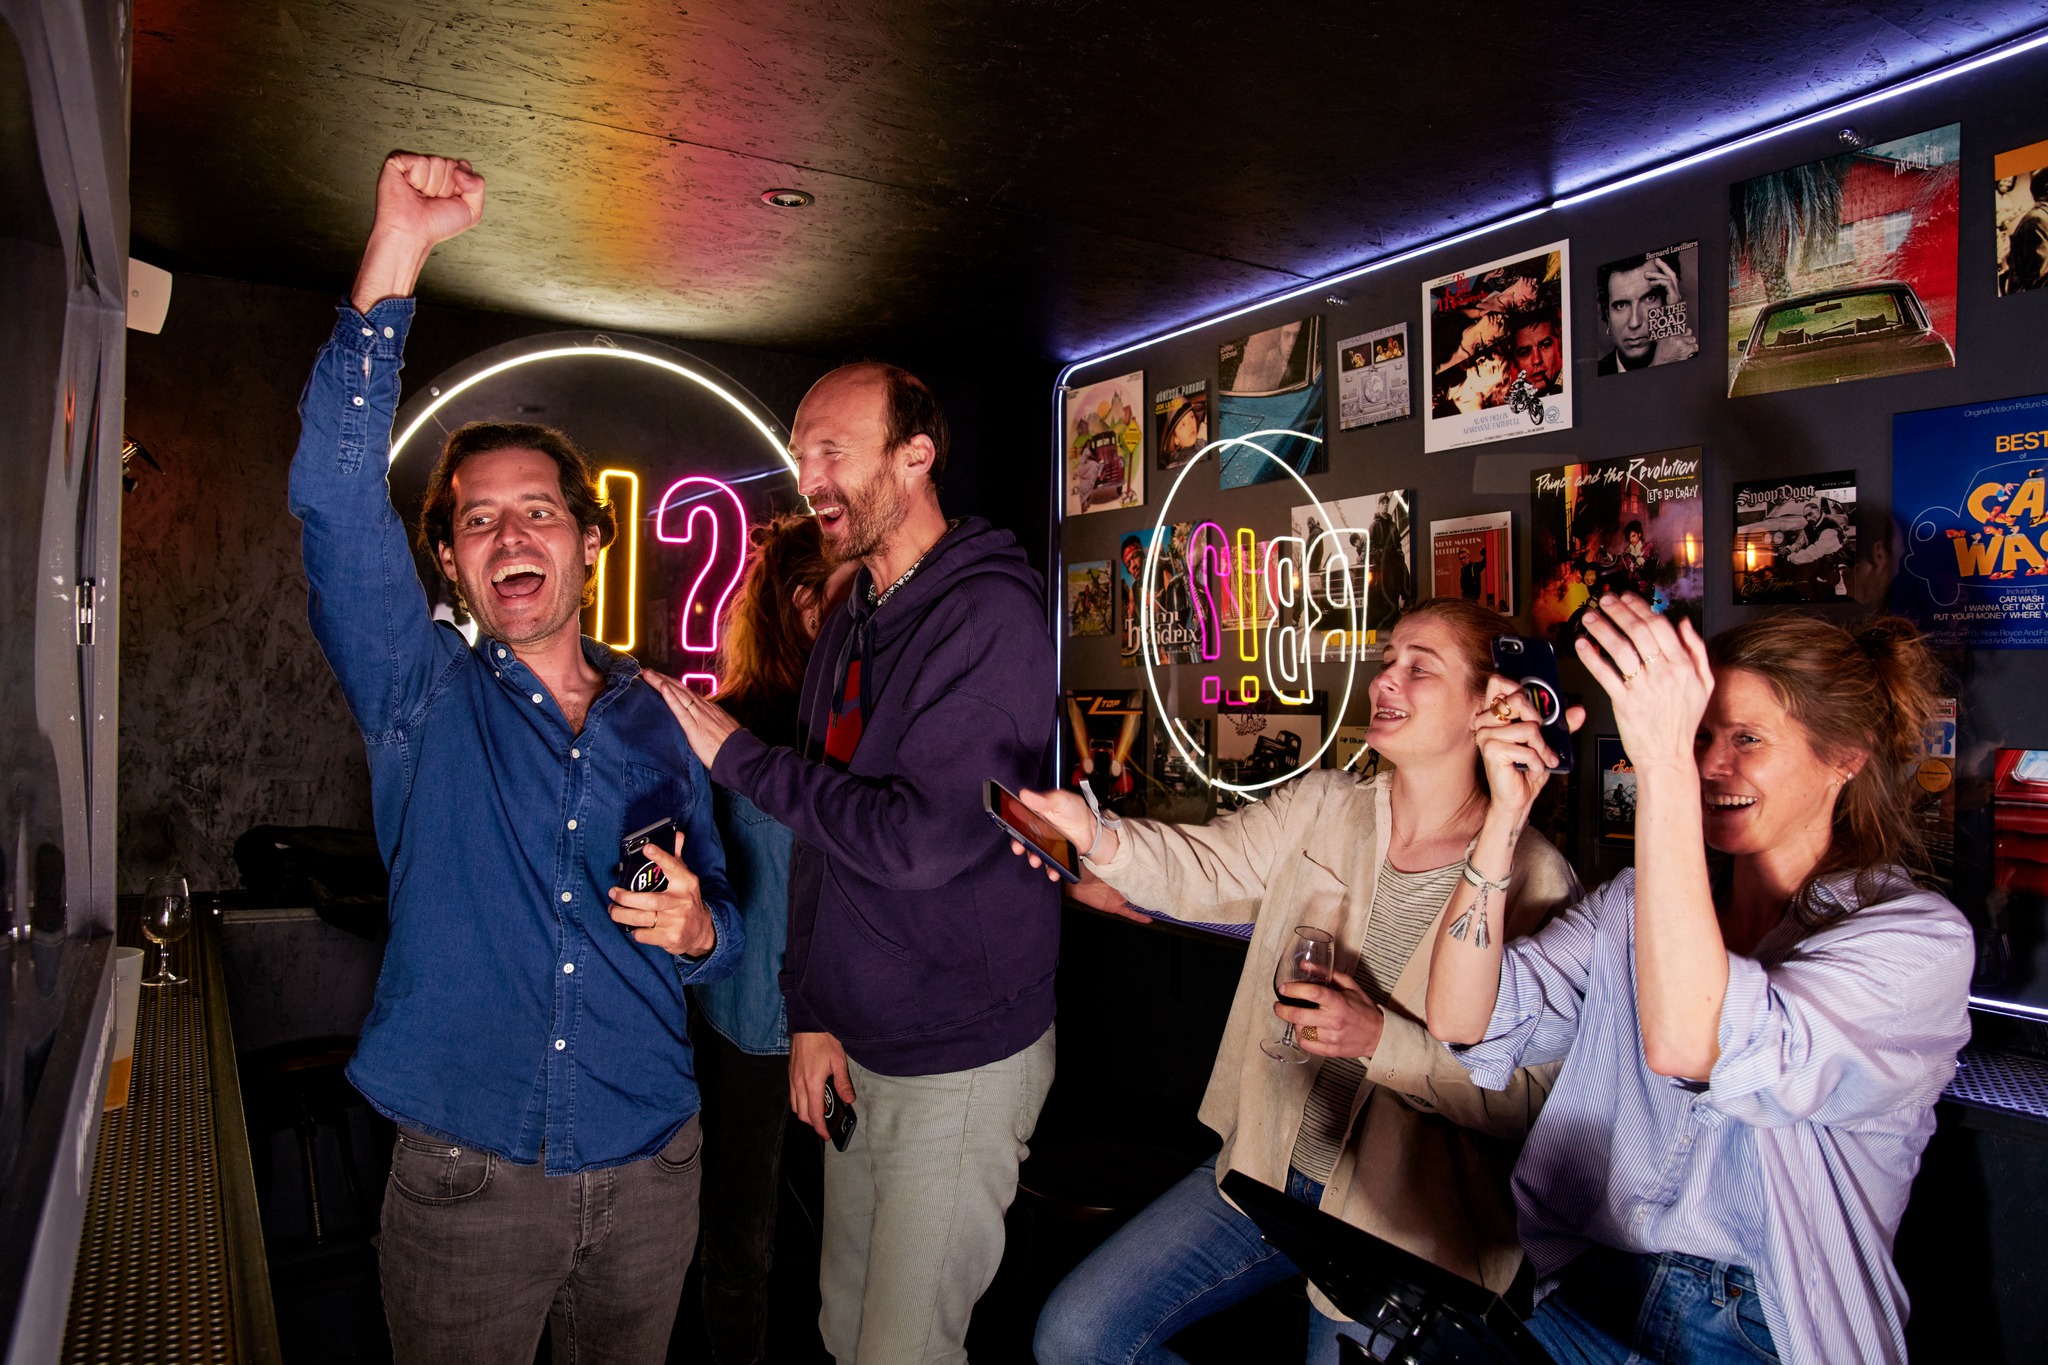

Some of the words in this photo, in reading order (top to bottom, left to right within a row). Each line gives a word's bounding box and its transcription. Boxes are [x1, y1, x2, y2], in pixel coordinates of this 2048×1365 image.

[1894, 152, 1929, 178] ARCADE
[1645, 246, 1670, 261] Bernard
[1670, 240, 1699, 254] Lavilliers
[1648, 307, 1664, 319] ON
[1666, 302, 1686, 315] THE
[1648, 312, 1687, 331] ROAD
[1964, 408, 1990, 417] Original
[1990, 405, 2015, 414] Motion
[2015, 402, 2041, 410] Picture
[2019, 452, 2027, 460] of
[1535, 473, 1573, 499] Prince
[1574, 467, 1602, 487] and
[1603, 466, 1625, 487] the
[1625, 457, 1699, 493] Revolution
[1735, 487, 1779, 508] Snoop
[1779, 484, 1816, 504] Dogg
[1967, 478, 2046, 524] CA
[1953, 531, 2048, 577] WA
[1969, 604, 2000, 612] WANNA
[2002, 603, 2020, 611] GET
[2021, 602, 2046, 611] NEXT
[1999, 595, 2017, 604] CAR
[2018, 594, 2045, 604] WASH
[1933, 613, 1949, 621] PUT
[1951, 612, 1975, 621] YOUR
[1975, 612, 2007, 620] MONEY
[2009, 611, 2042, 619] WHERE
[1981, 629, 1999, 637] Rose
[2000, 629, 2023, 638] Royce
[2023, 628, 2039, 637] And
[1100, 699, 1122, 708] TOP
